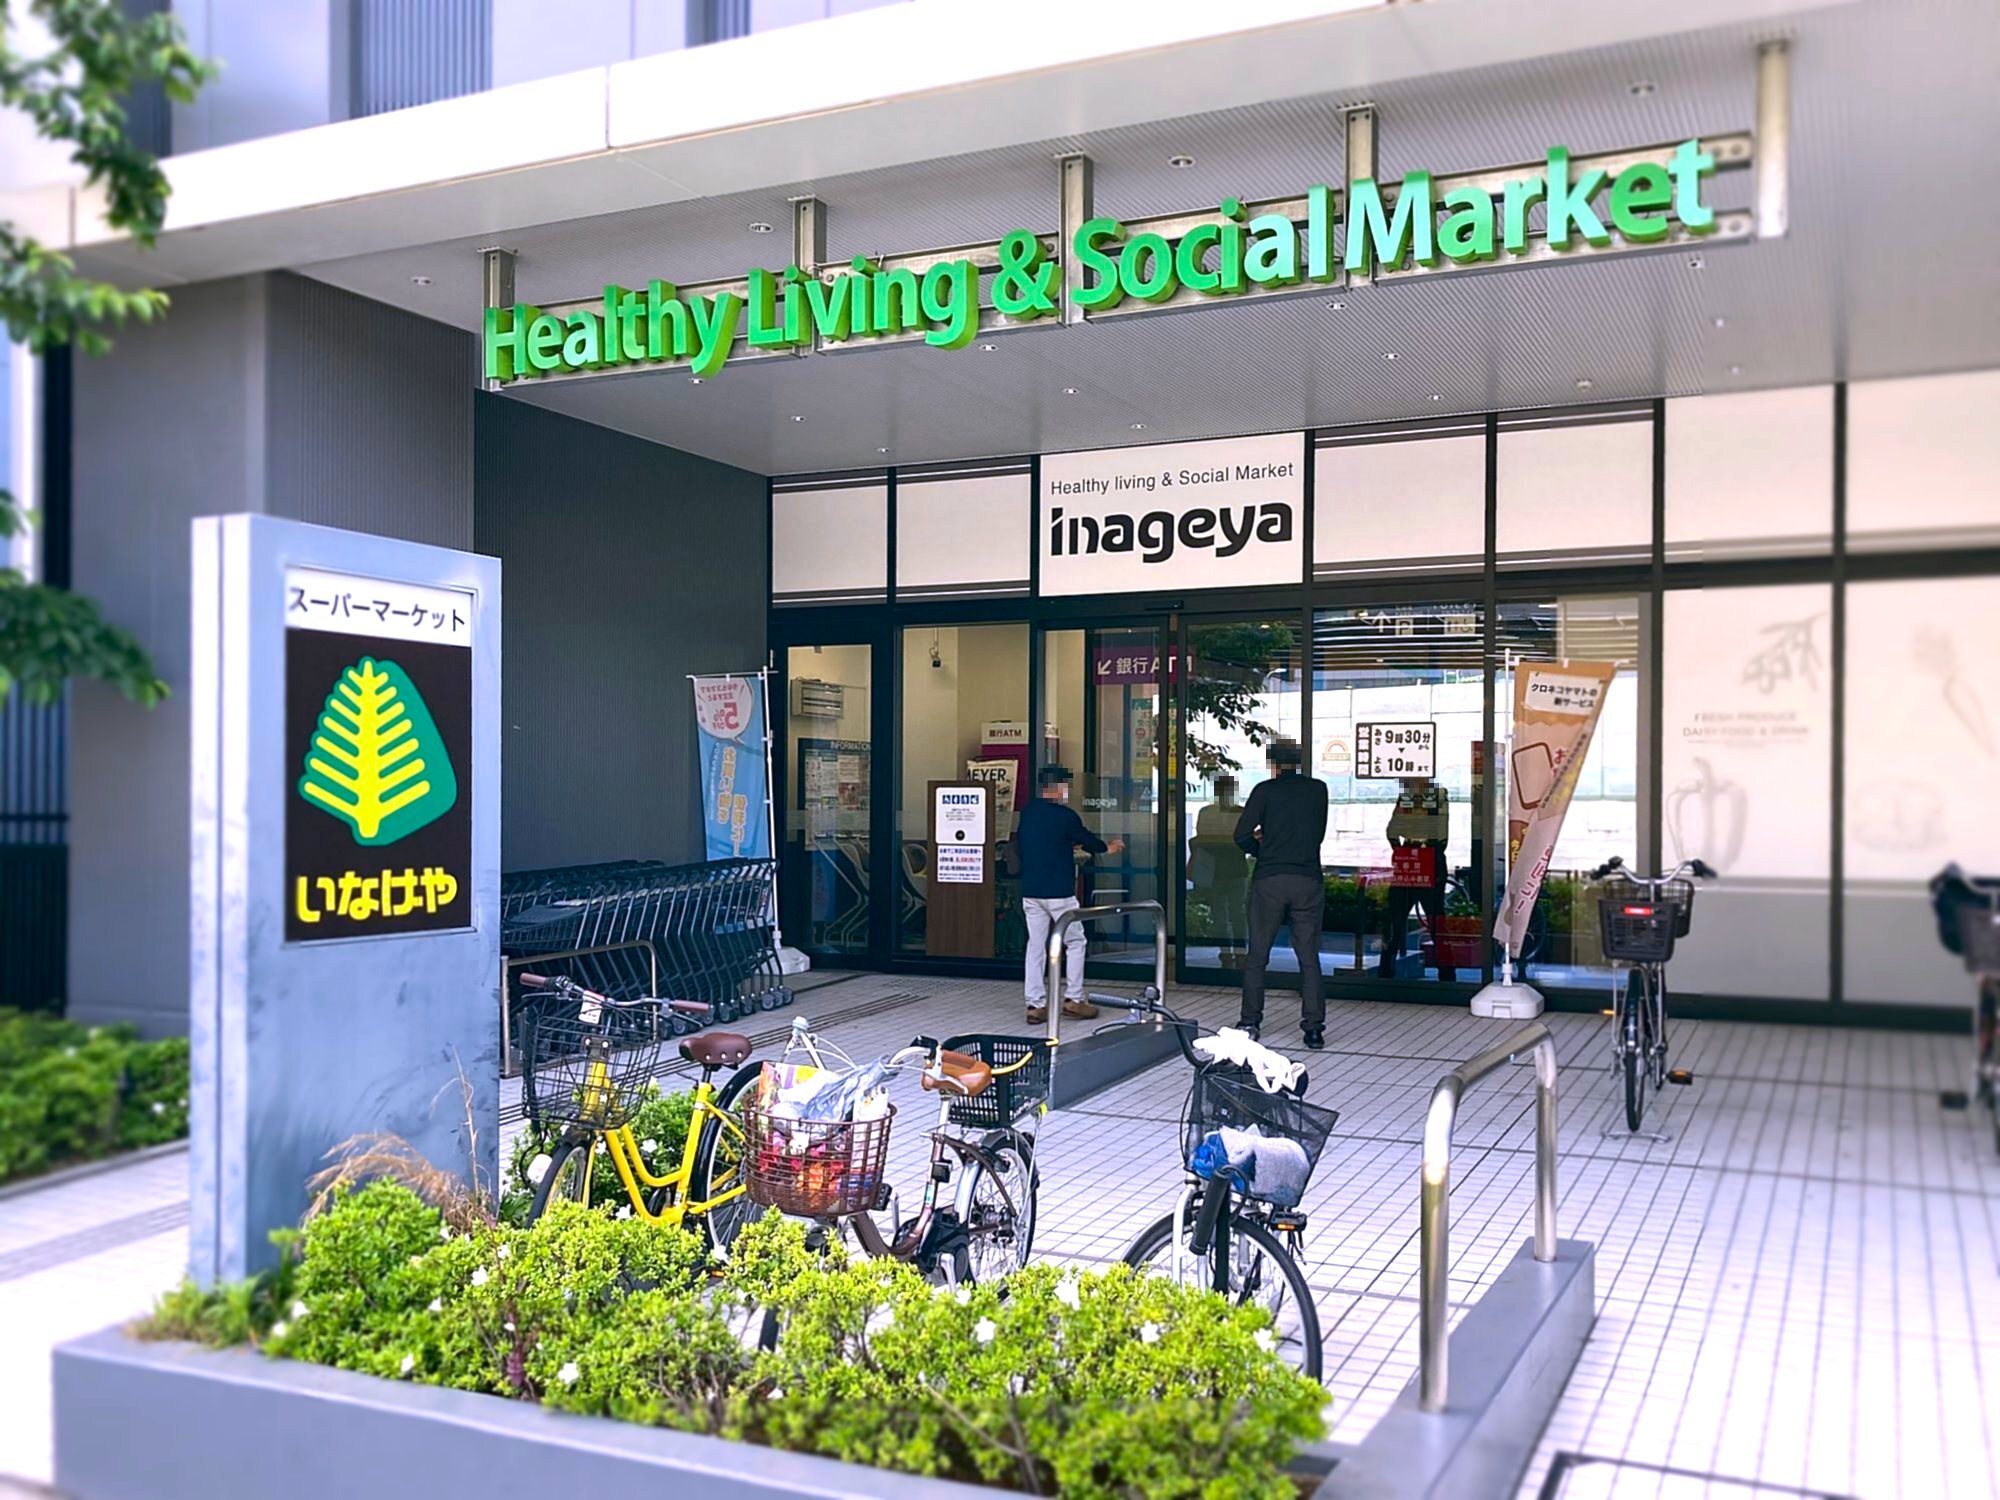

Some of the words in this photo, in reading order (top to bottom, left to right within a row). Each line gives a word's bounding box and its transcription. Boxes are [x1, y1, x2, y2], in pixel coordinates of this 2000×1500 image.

[484, 278, 742, 378] Healthy
[747, 255, 979, 351] Living
[991, 228, 1063, 321] &
[1070, 183, 1336, 310] Social
[1343, 137, 1717, 277] Market
[1051, 478, 1109, 495] Healthy
[1115, 475, 1156, 492] living
[1161, 471, 1173, 486] &
[1179, 466, 1229, 485] Social
[1236, 461, 1294, 480] Market
[1051, 502, 1293, 563] inageya
[288, 587, 465, 632] スーパーマーケット
[1531, 683, 1598, 697] クロネコヤマトの
[1387, 758, 1415, 772] 10時
[1082, 796, 1118, 809] inageya
